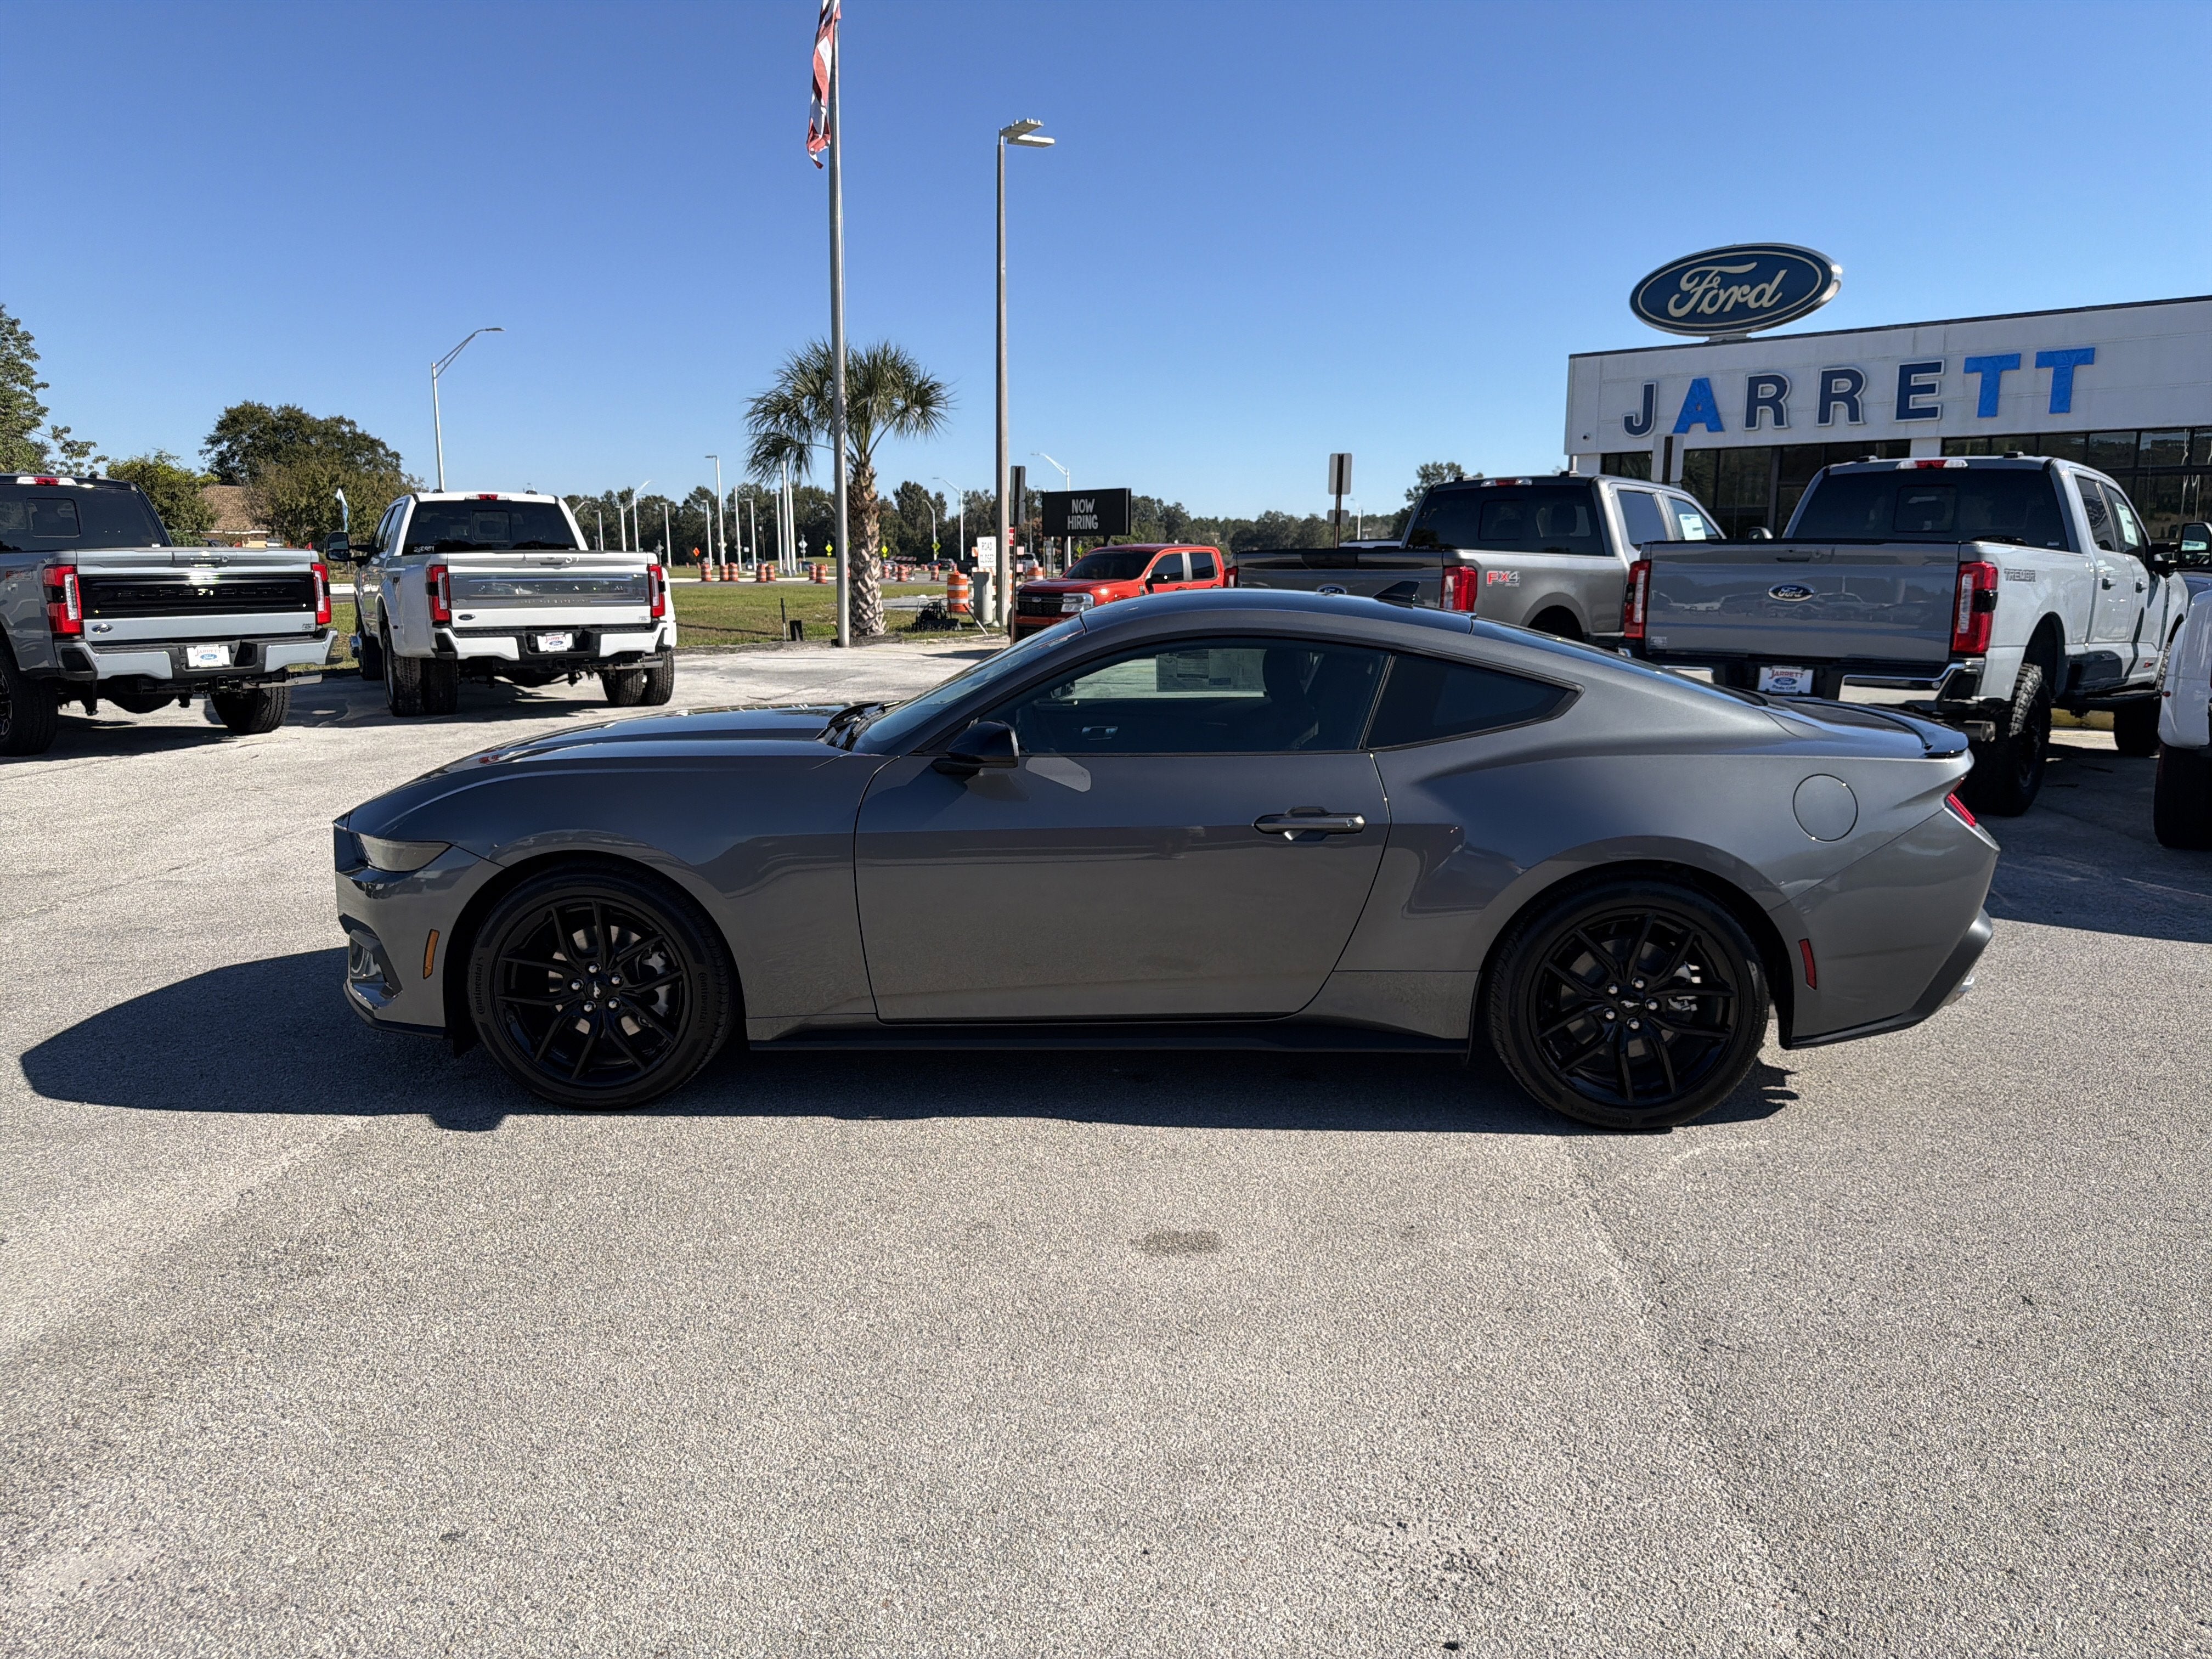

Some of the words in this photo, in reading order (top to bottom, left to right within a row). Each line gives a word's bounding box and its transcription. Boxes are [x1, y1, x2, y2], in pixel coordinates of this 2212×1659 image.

[1668, 262, 1787, 317] Ford
[1622, 347, 2096, 437] JARRETT
[1071, 499, 1096, 514] NOW
[1067, 515, 1099, 531] HIRING
[981, 542, 992, 551] ROAD
[1486, 571, 1520, 586] FX4
[2004, 568, 2036, 582] TREMOR
[1778, 587, 1803, 597] Ford
[1768, 669, 1804, 680] JARRETT
[475, 963, 484, 1015] Continental
